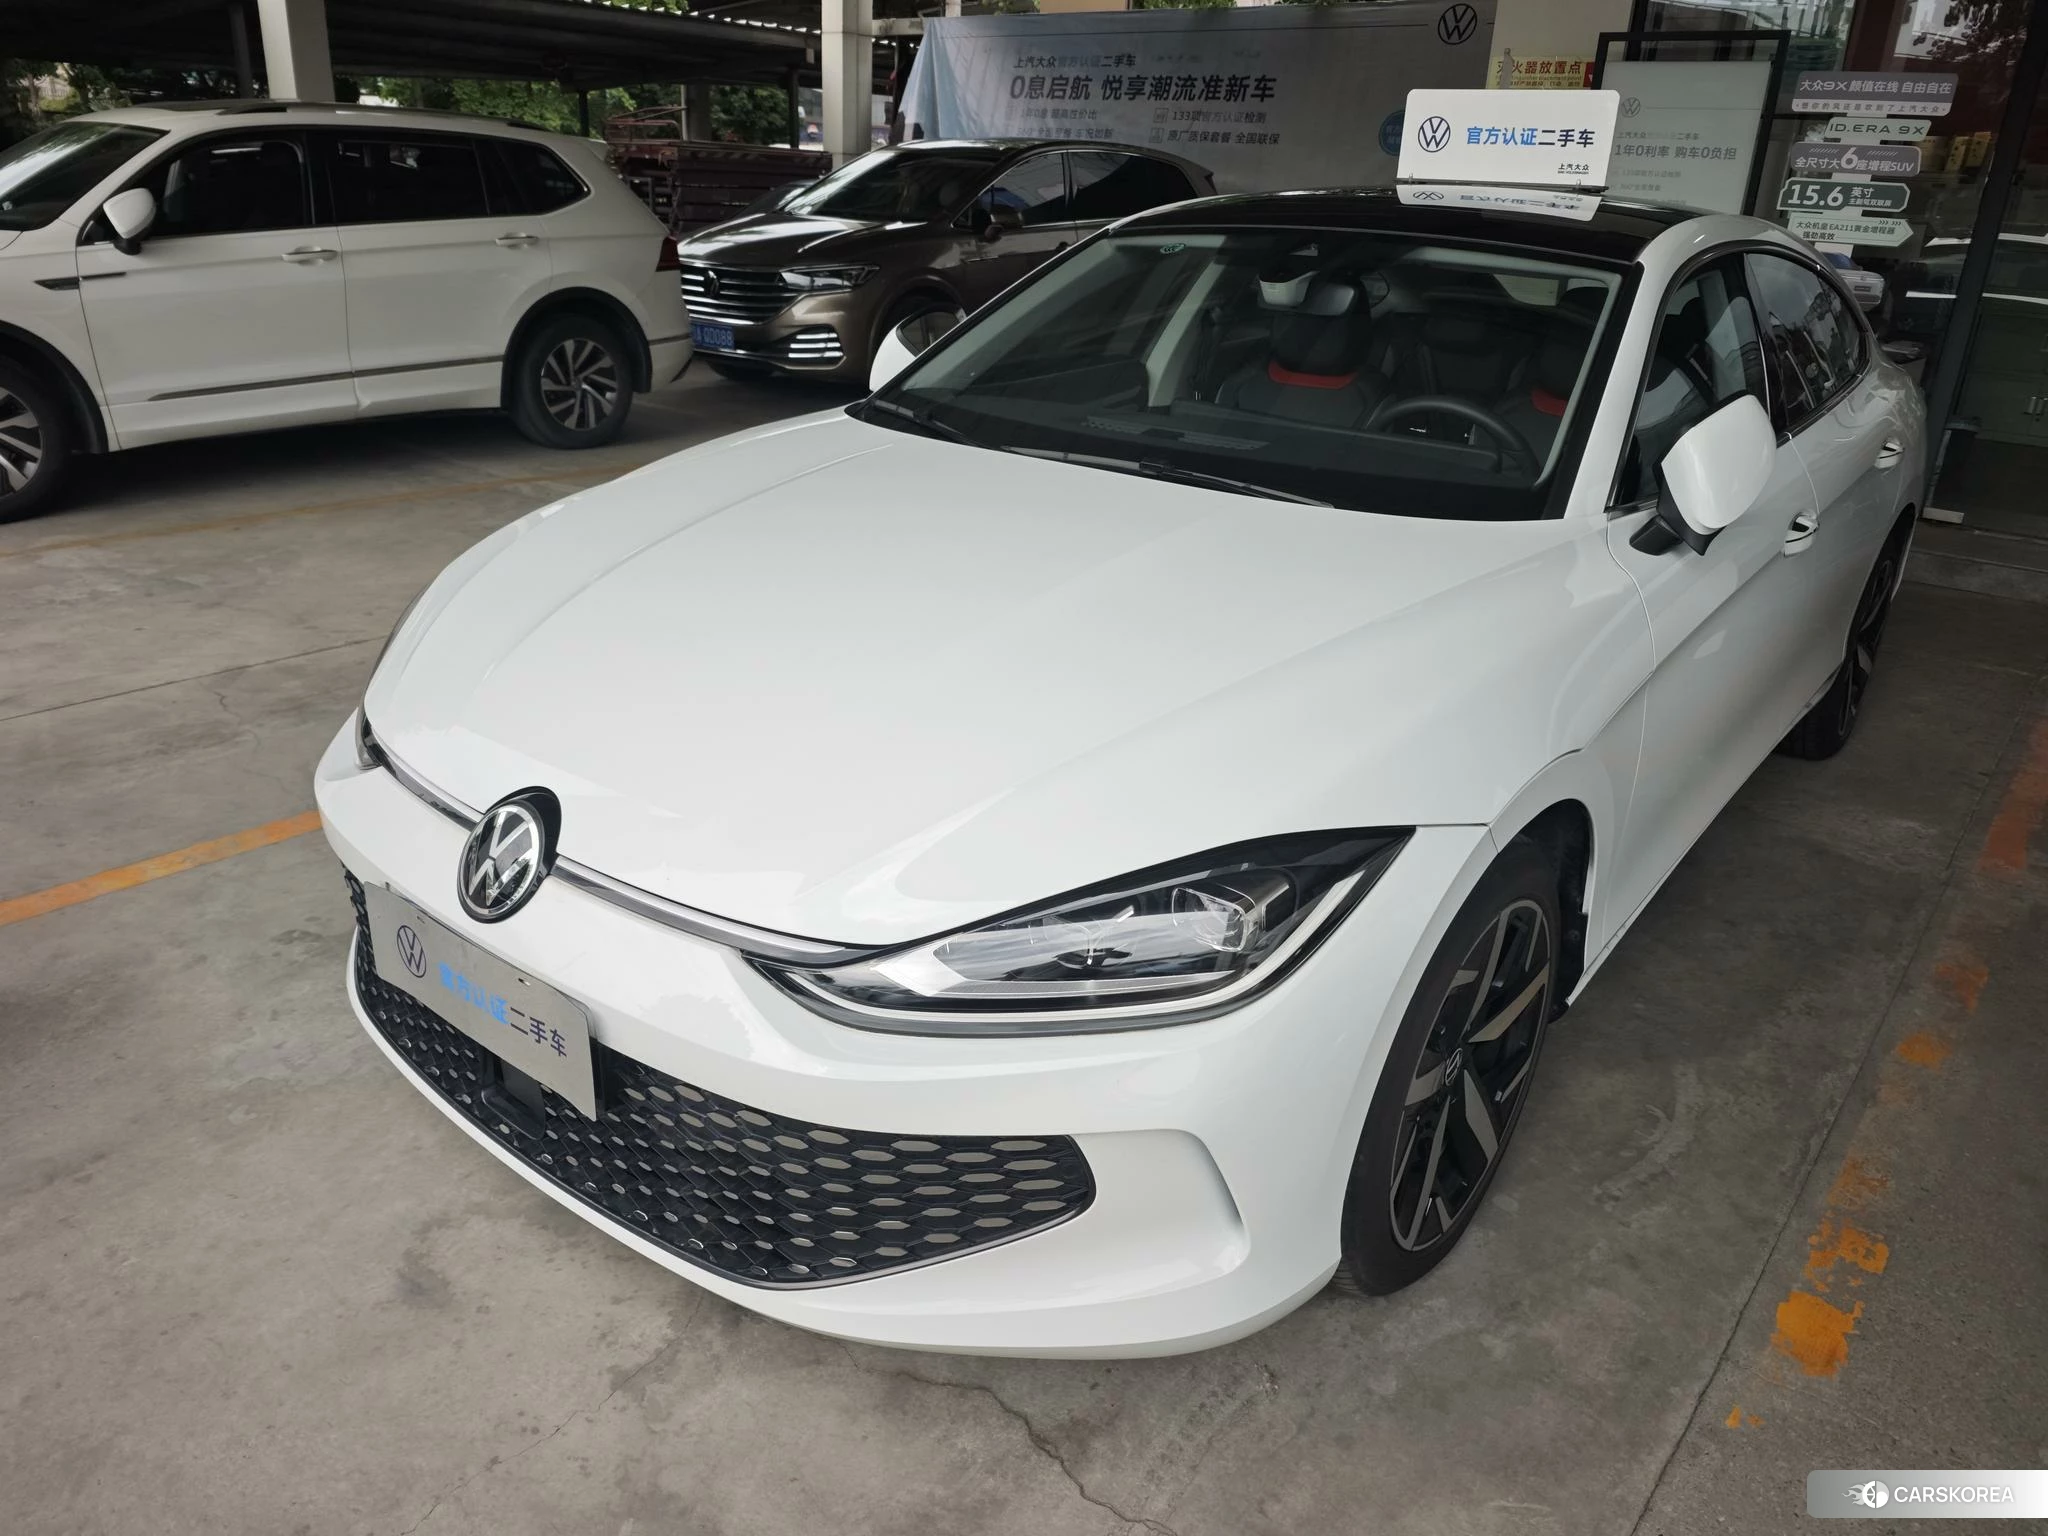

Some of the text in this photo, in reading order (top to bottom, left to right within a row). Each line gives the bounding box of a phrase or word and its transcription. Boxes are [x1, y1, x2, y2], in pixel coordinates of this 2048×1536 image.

[1013, 53, 1136, 69] 上汽大众官方认证二手车
[1009, 73, 1278, 103] 0息启航 悦享潮流准新车
[1799, 79, 1953, 95] 大众9X 颜值在线 自由自在
[1172, 110, 1267, 125] 133项官方认证检测
[1829, 123, 1926, 136] ID.ERA 9X
[1166, 130, 1280, 145] 原厂质保套餐 全国联保
[1466, 126, 1596, 149] 官方认证二手车
[1614, 143, 1737, 161] 1年0利率 购车0负担
[1557, 162, 1590, 172] 上汽大众
[1787, 184, 1844, 207] 15.6
[1850, 186, 1875, 199] 英寸
[1802, 231, 1836, 242] 强劲高效
